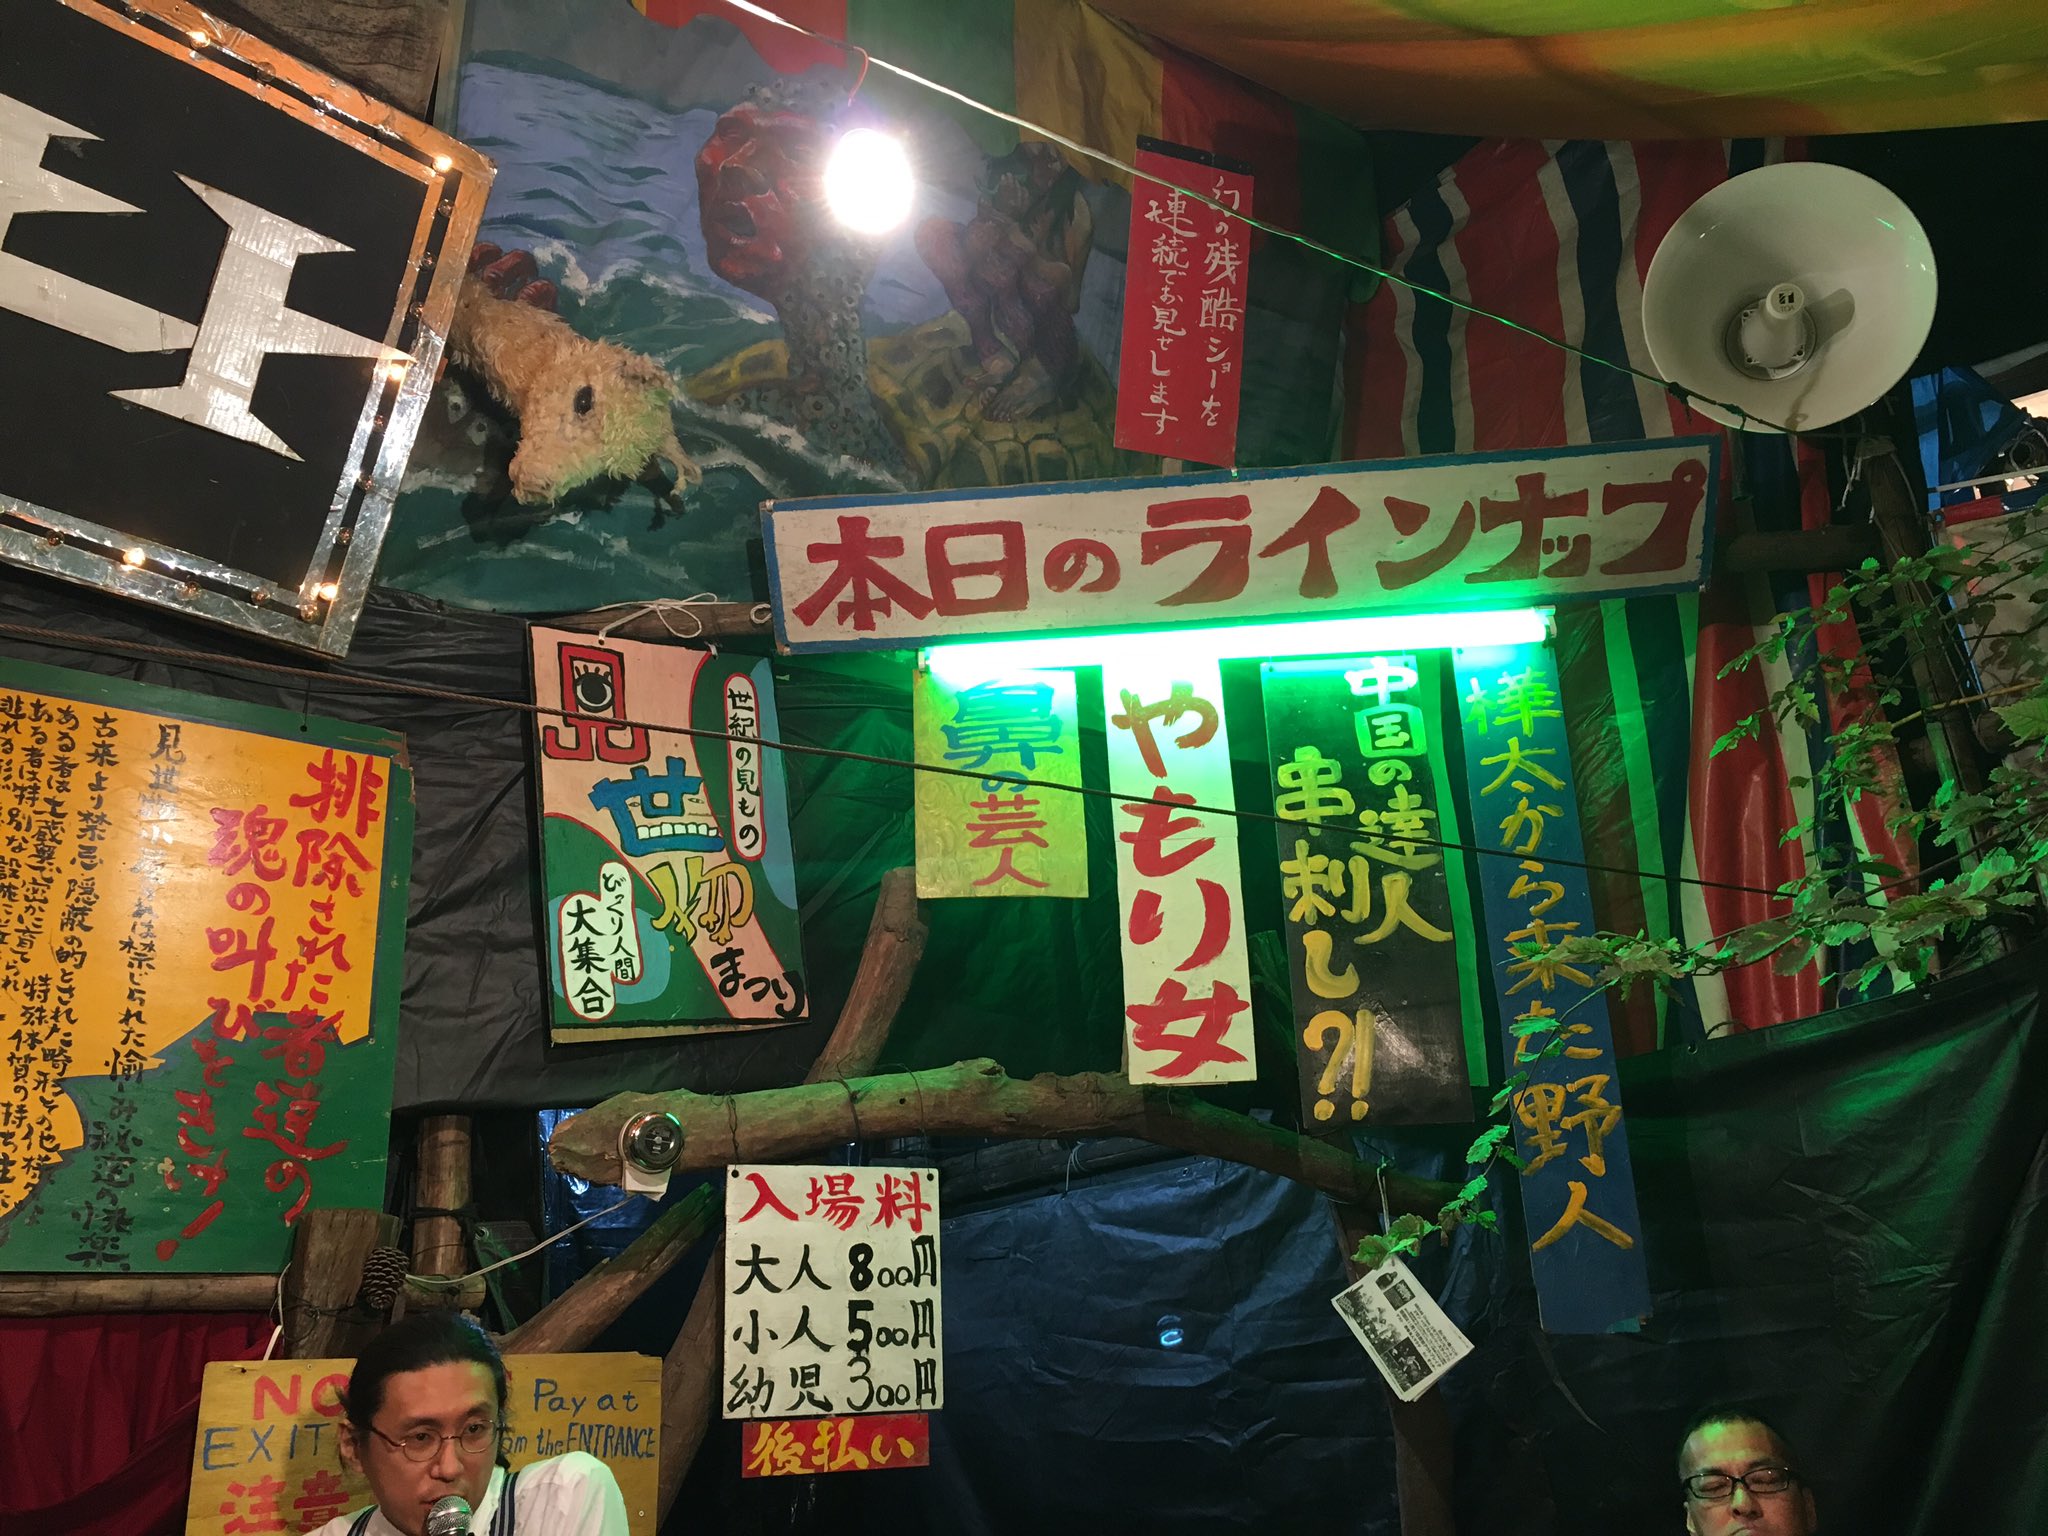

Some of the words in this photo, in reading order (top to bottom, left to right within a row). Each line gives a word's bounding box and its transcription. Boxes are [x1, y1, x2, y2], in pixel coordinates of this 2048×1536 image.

[1140, 188, 1197, 435] 連続でお見せします
[793, 458, 1705, 631] 本日のラインナップ
[726, 688, 760, 850] 世紀の見もの
[940, 680, 1063, 888] 鼻の芸人
[1344, 655, 1453, 945] 中国の達人
[1111, 679, 1250, 1079] やもり女
[566, 898, 610, 1014] 大集合
[602, 871, 637, 981] びっくり人間
[738, 1172, 932, 1233] 入場料
[732, 1243, 832, 1294] 大人
[848, 1234, 937, 1292] 800円
[732, 1305, 836, 1354] 小人
[847, 1298, 935, 1351] 500円
[534, 1378, 587, 1418] Pay
[597, 1391, 639, 1412] at
[726, 1362, 834, 1414] 幼児
[847, 1356, 936, 1411] 300円
[203, 1423, 332, 1471] EXIT
[536, 1428, 564, 1456] the
[566, 1422, 656, 1459] ENTRANCE
[747, 1418, 915, 1476] 後払い
